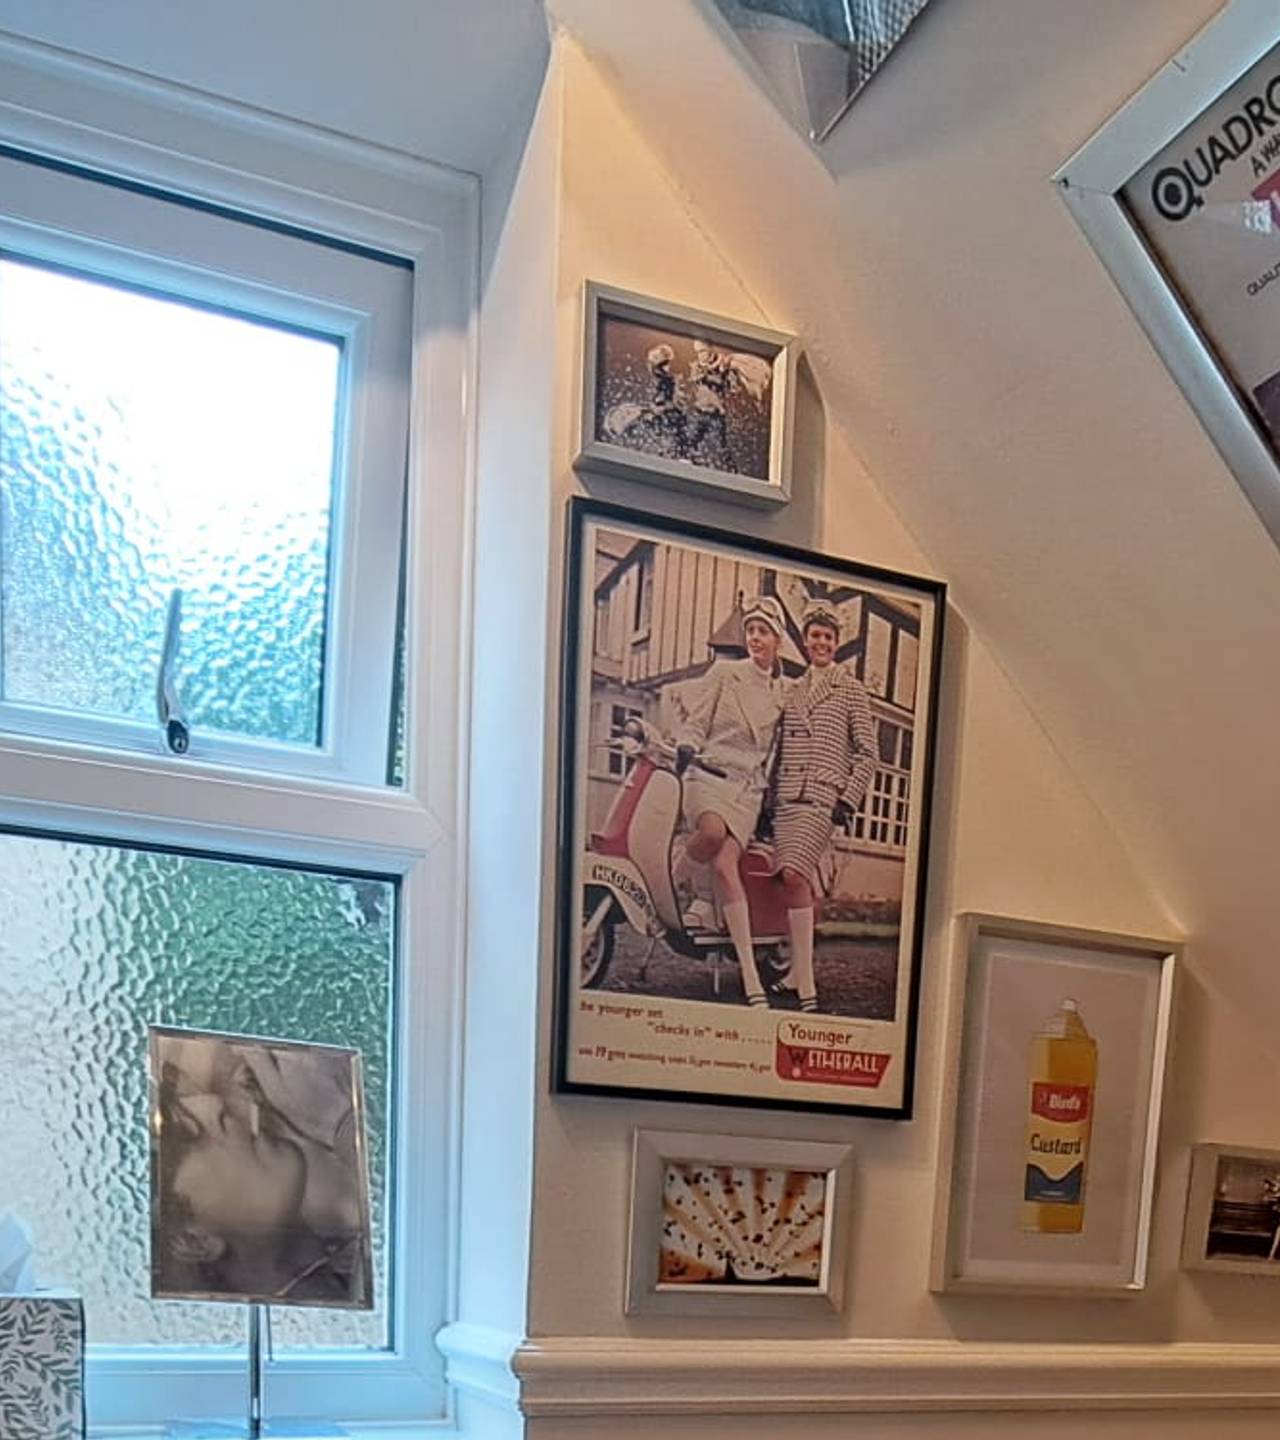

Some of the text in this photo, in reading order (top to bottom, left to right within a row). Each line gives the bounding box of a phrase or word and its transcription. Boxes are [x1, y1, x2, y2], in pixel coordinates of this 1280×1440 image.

[1251, 155, 1267, 179] A
[788, 1023, 854, 1047] Younger
[1030, 1132, 1083, 1155] Custard
